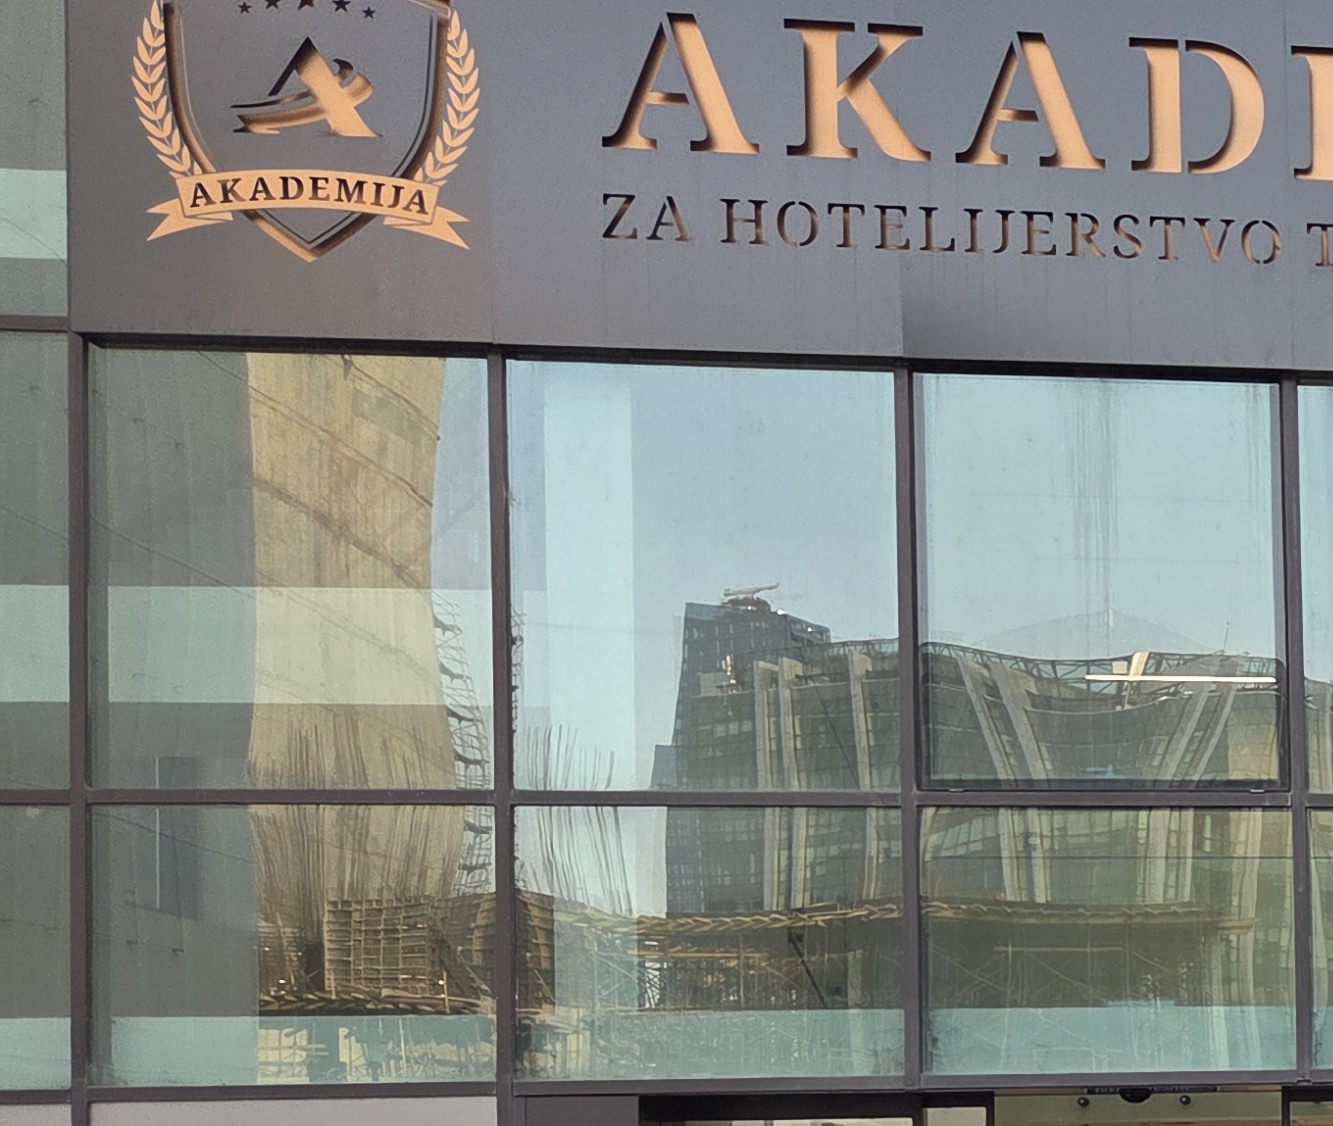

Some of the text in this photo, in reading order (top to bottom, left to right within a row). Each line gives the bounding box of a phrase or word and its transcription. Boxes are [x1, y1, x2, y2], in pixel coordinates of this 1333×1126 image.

[190, 173, 431, 217] AKADEMIJA
[602, 194, 694, 242] ZA
[719, 197, 1283, 265] HOTELIJERSTVO
